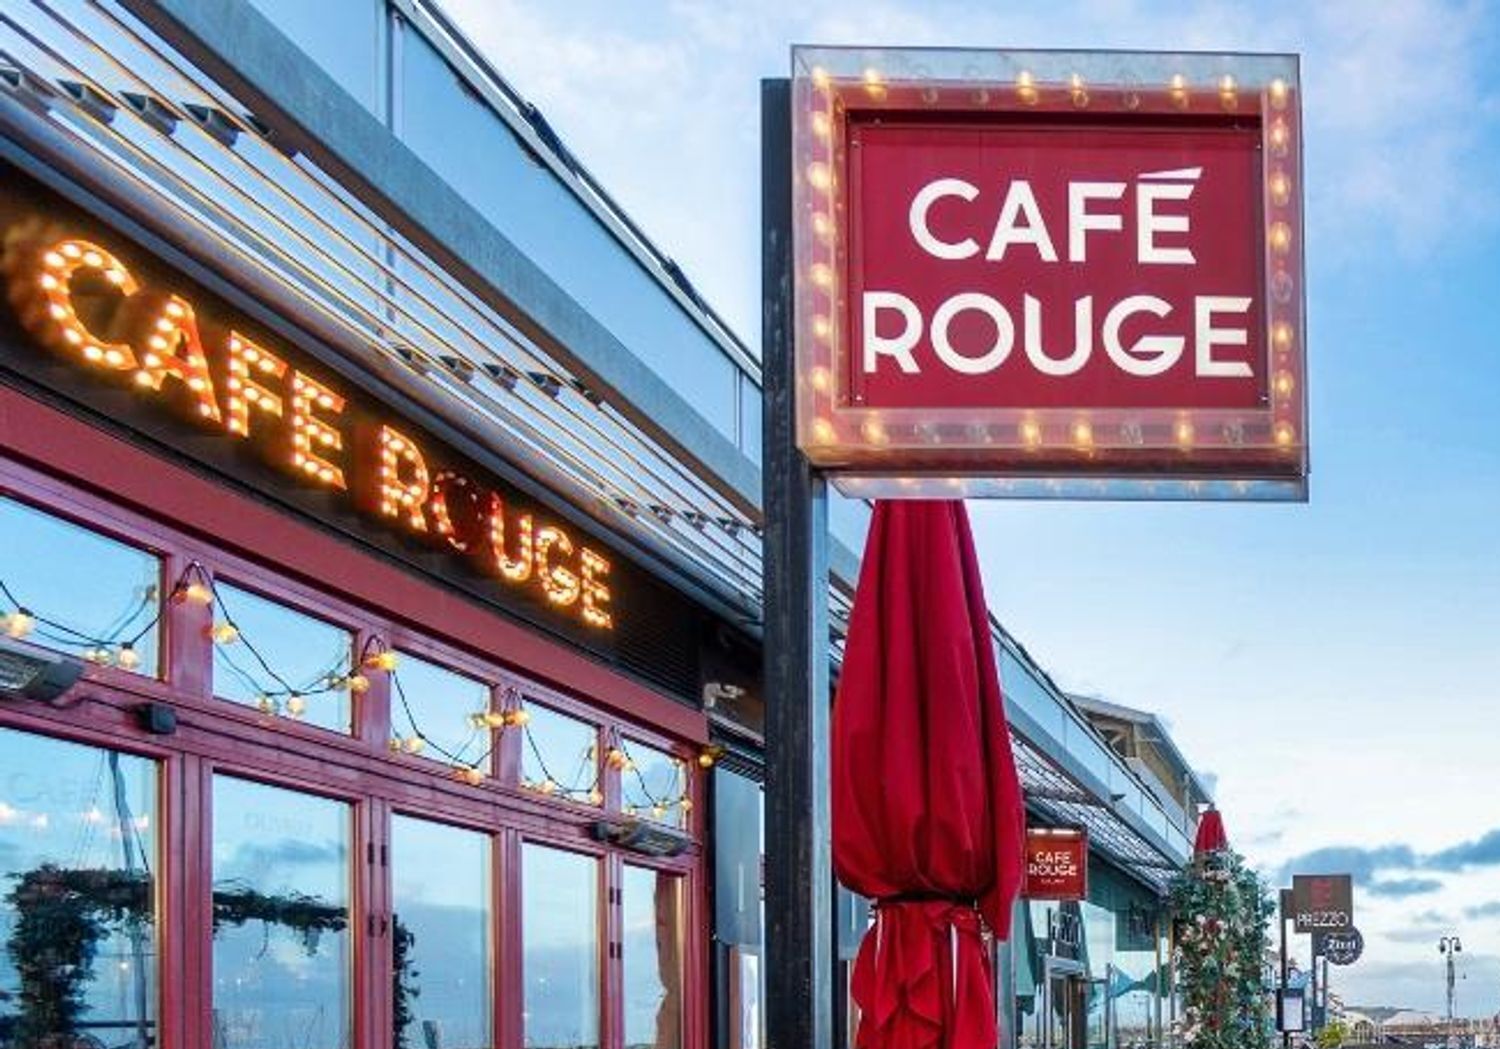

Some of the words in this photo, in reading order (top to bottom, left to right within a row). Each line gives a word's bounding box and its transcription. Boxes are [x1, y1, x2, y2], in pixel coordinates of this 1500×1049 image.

[908, 165, 1204, 265] CAFÉ
[862, 291, 1255, 378] ROUGE
[39, 239, 347, 491] CAFE
[379, 423, 614, 630] ROUGE
